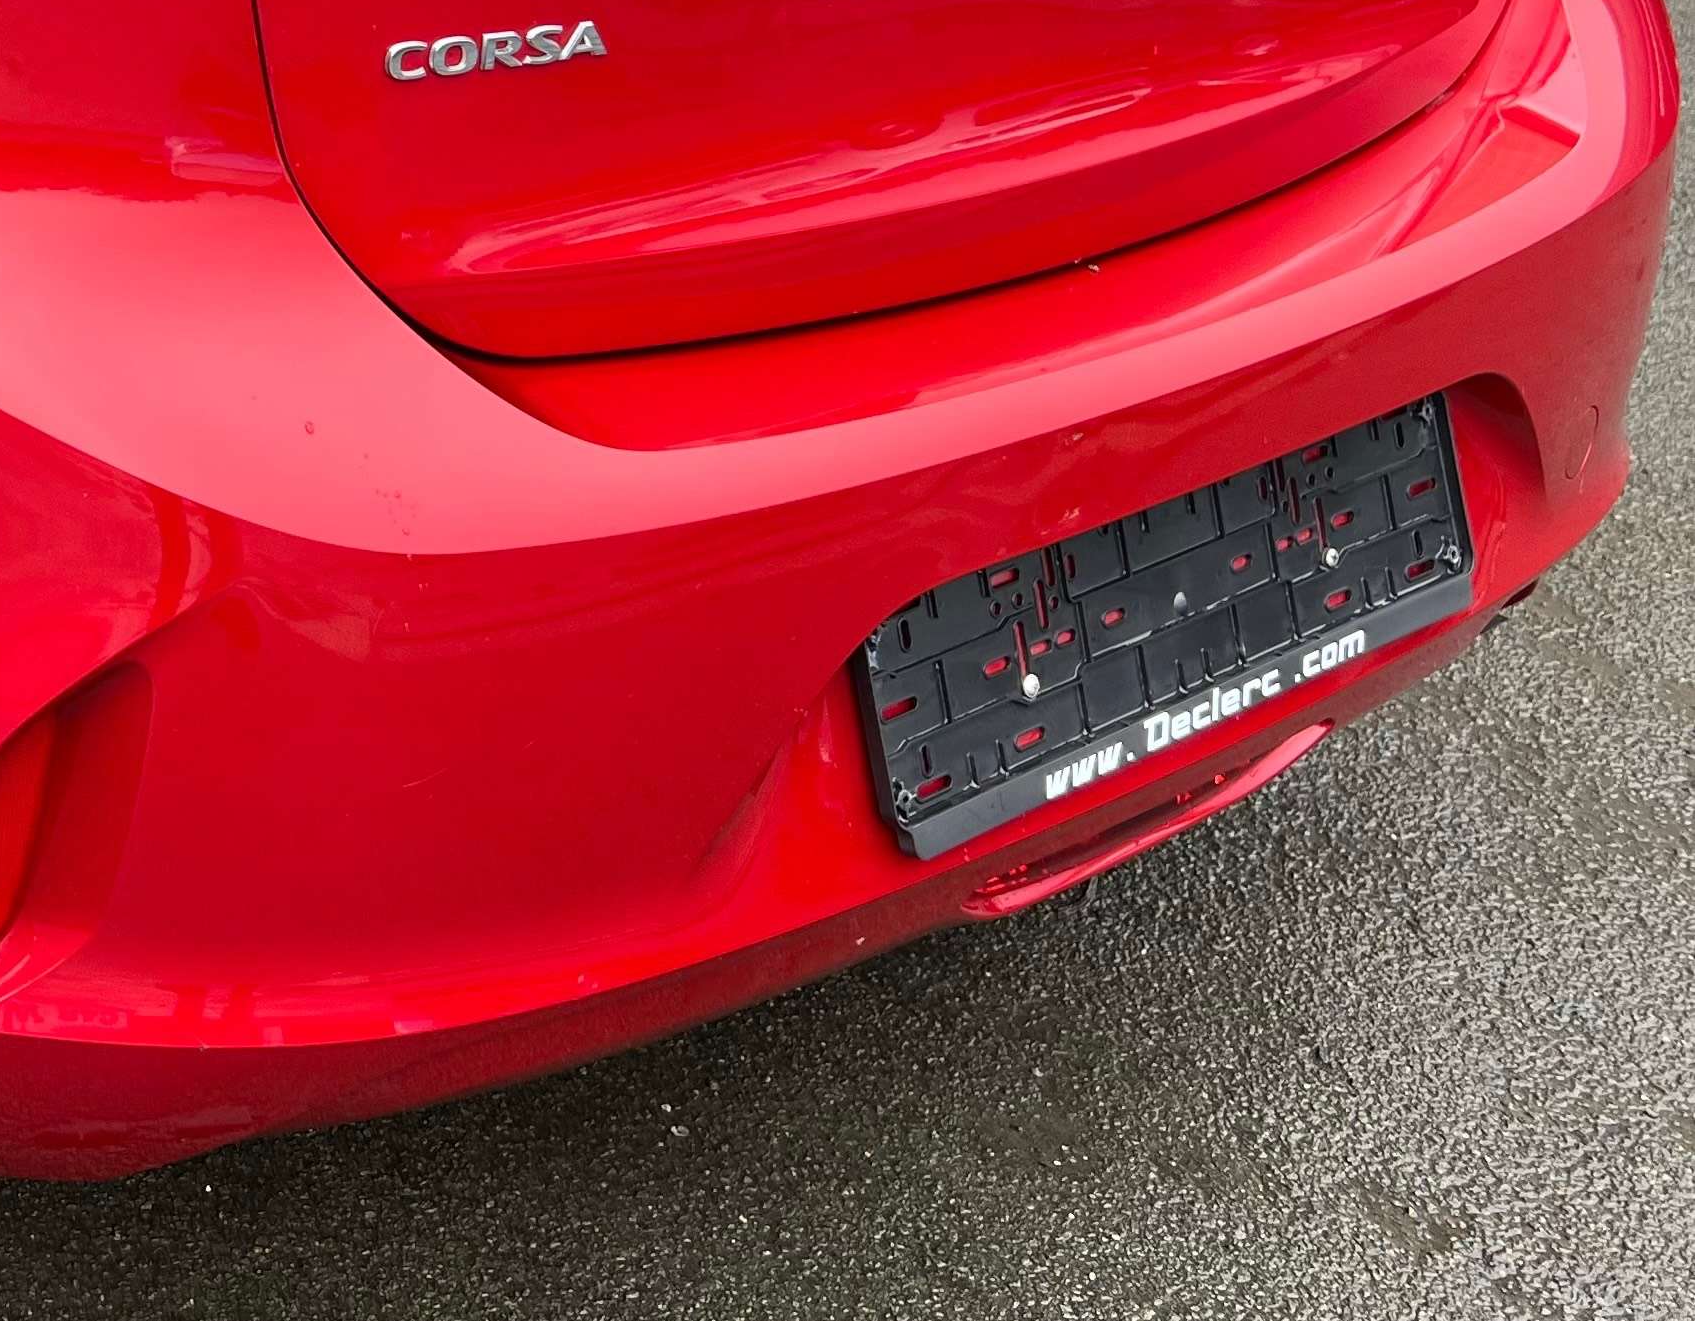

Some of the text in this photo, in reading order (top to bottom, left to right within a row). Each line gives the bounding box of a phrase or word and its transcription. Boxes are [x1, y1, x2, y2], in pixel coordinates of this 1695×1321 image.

[384, 20, 607, 81] CORSA
[1045, 742, 1136, 801] www.
[1143, 669, 1282, 753] Declerc
